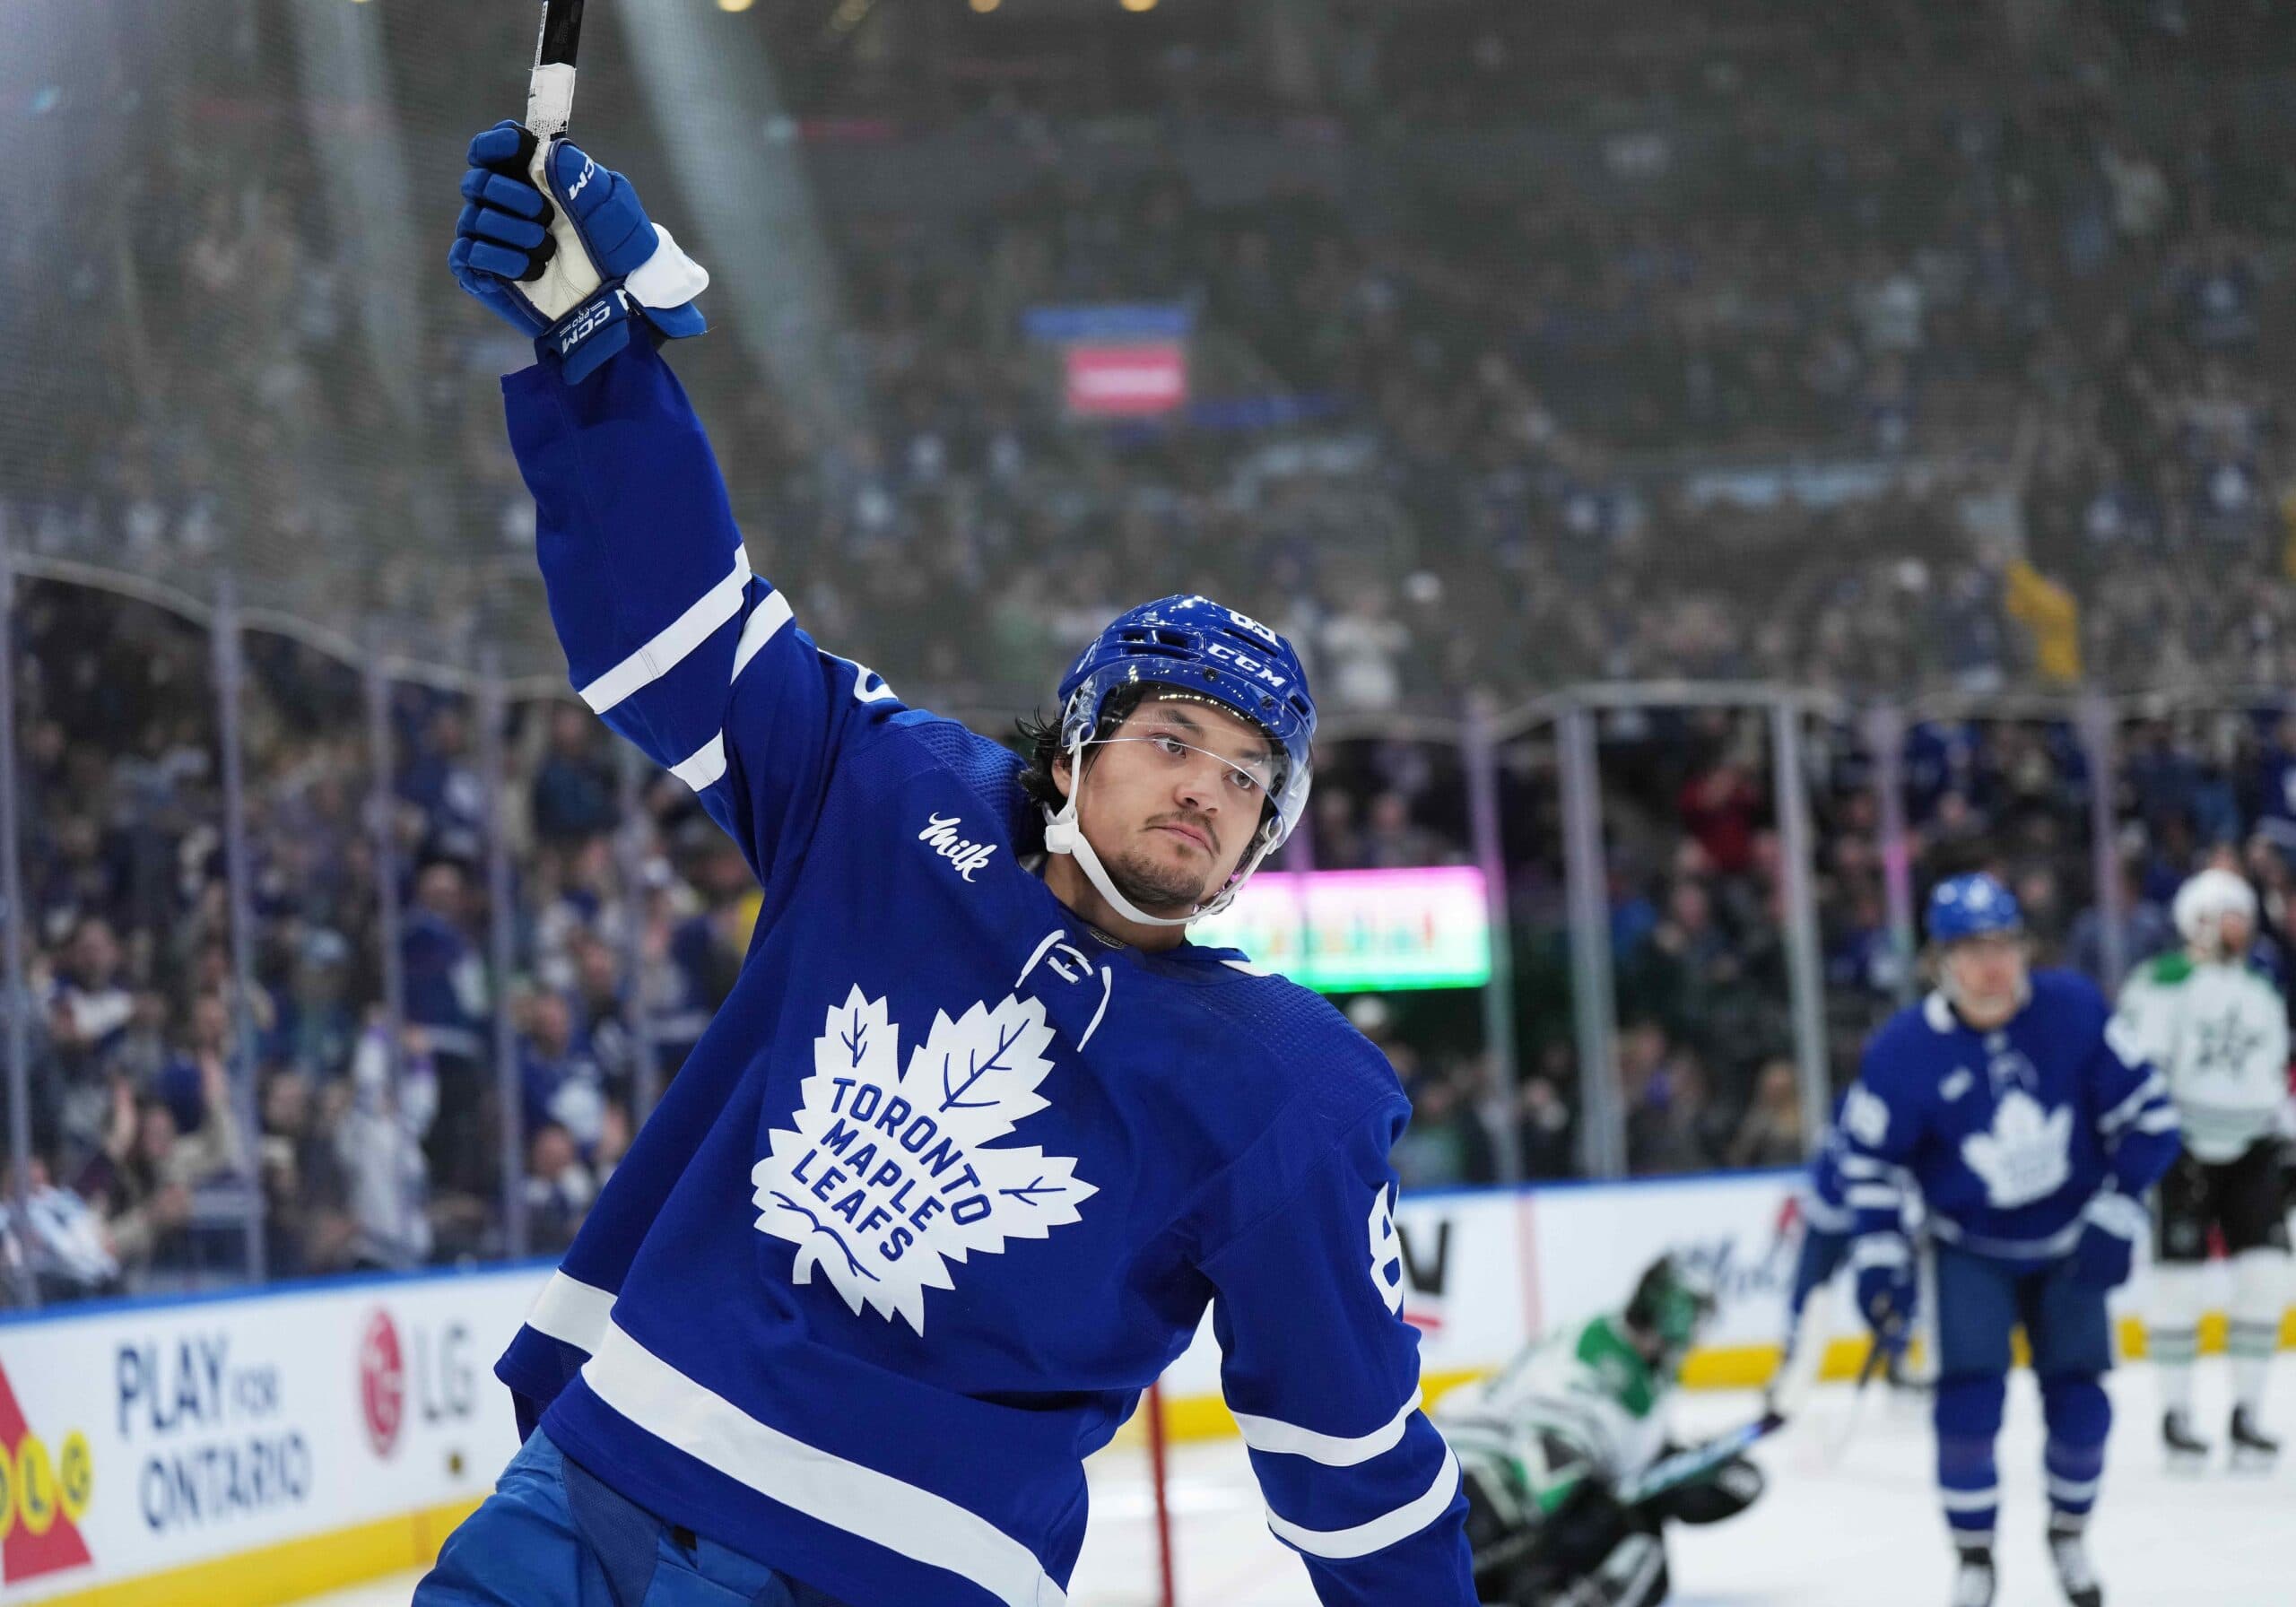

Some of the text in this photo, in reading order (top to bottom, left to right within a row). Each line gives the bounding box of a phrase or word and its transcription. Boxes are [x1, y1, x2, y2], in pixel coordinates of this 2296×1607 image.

[568, 153, 595, 200] CM
[561, 306, 611, 354] CCM
[1207, 642, 1287, 688] CCM
[918, 812, 997, 882] Milk
[820, 1117, 945, 1232] MAPLE
[831, 1077, 992, 1226] TORONTO
[791, 1149, 914, 1262] LEAFS
[116, 1336, 229, 1438] PLAY
[413, 1323, 477, 1426] LG
[137, 1431, 311, 1532] ONTARIO
